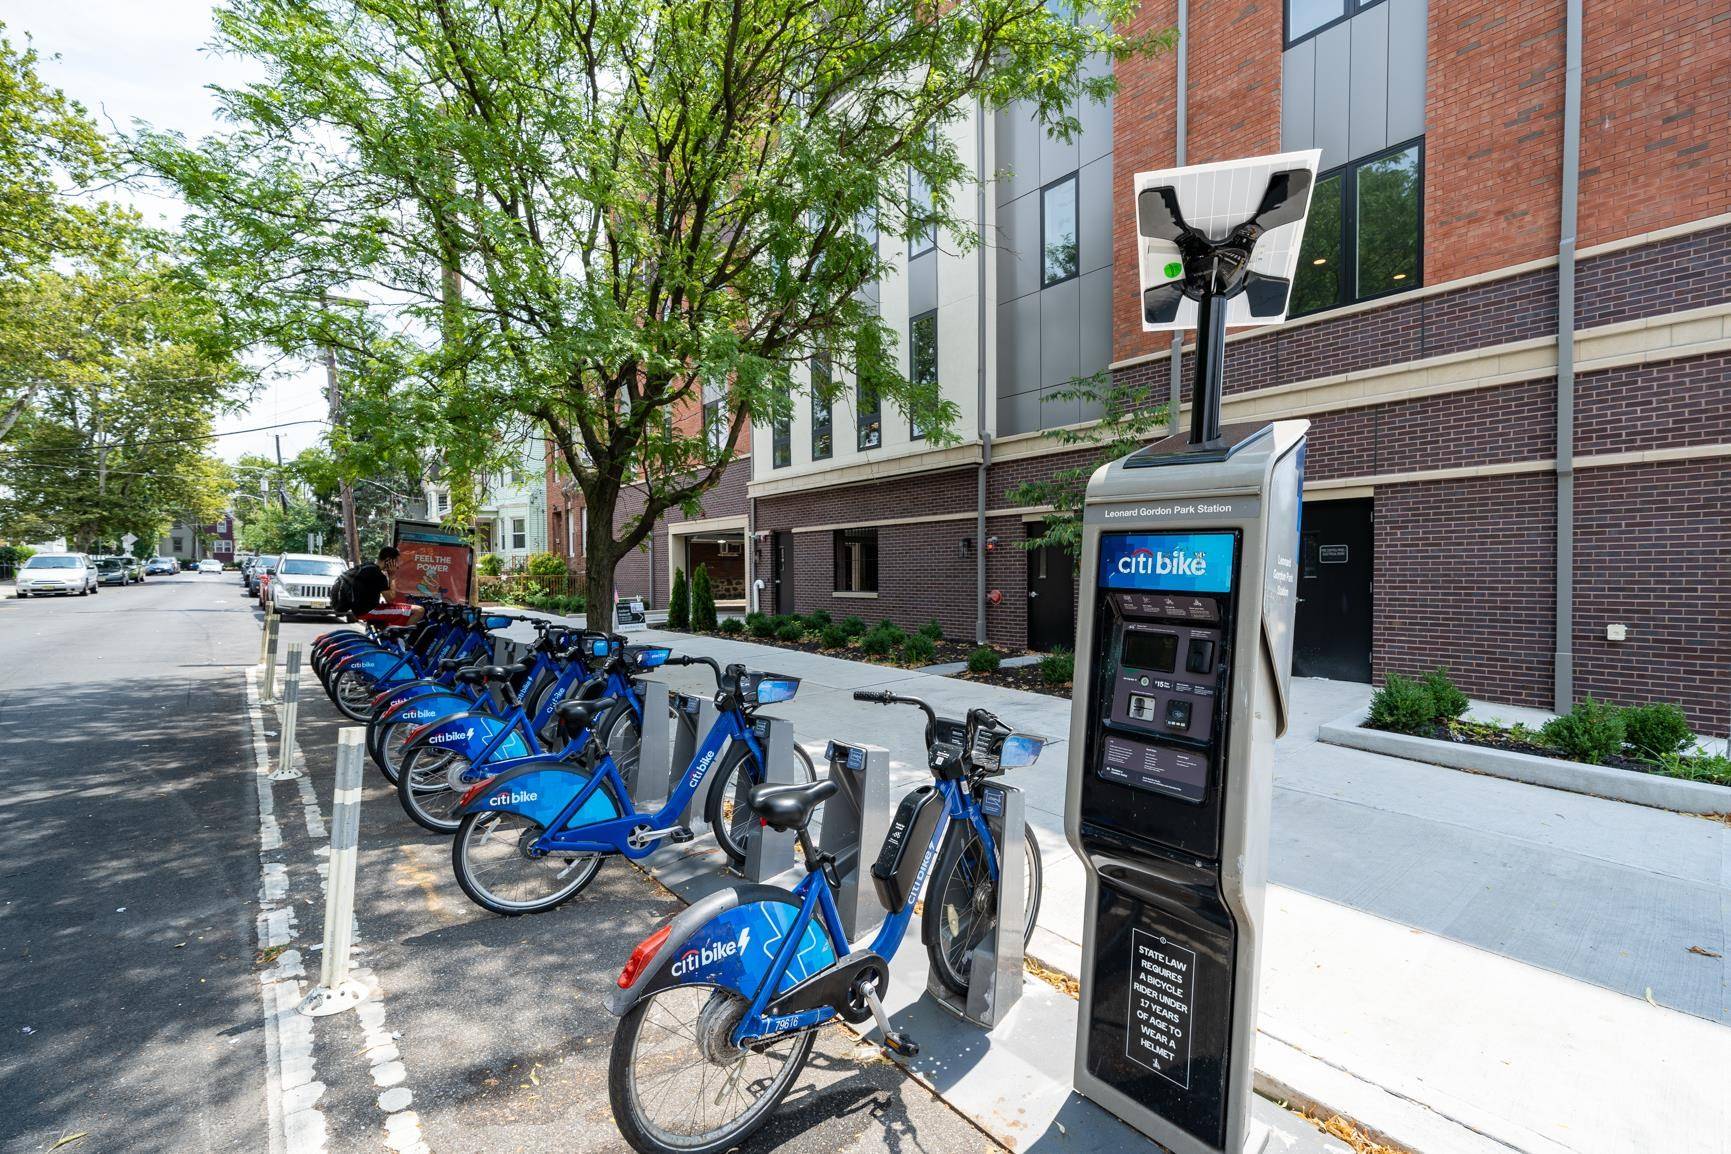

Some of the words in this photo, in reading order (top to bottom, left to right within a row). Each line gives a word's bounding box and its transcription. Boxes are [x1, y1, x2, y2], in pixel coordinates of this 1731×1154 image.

[1105, 509, 1138, 518] Leonard
[1140, 507, 1172, 516] Gordon
[1174, 505, 1195, 514] Park
[1197, 503, 1232, 513] Station
[414, 554, 434, 563] FEEL
[435, 556, 452, 564] THE
[416, 563, 449, 572] POWER
[1139, 945, 1165, 963] STATE
[1165, 956, 1187, 971] LAW
[1141, 959, 1183, 984] REQUIRES
[1139, 972, 1146, 981] A
[1147, 974, 1184, 998] BICYCLE
[1133, 982, 1158, 1000] RIDER
[1159, 993, 1188, 1014] UNDER
[1140, 998, 1150, 1008] 17
[1150, 1002, 1180, 1023] YEARS
[775, 1017, 799, 1032] 79616
[1136, 1010, 1149, 1020] OF
[1149, 1016, 1168, 1032] AGE
[1168, 1025, 1182, 1037] TO
[1140, 1037, 1175, 1061] HELMET
[1141, 1024, 1168, 1045] WEAR
[1169, 1039, 1176, 1049] A
